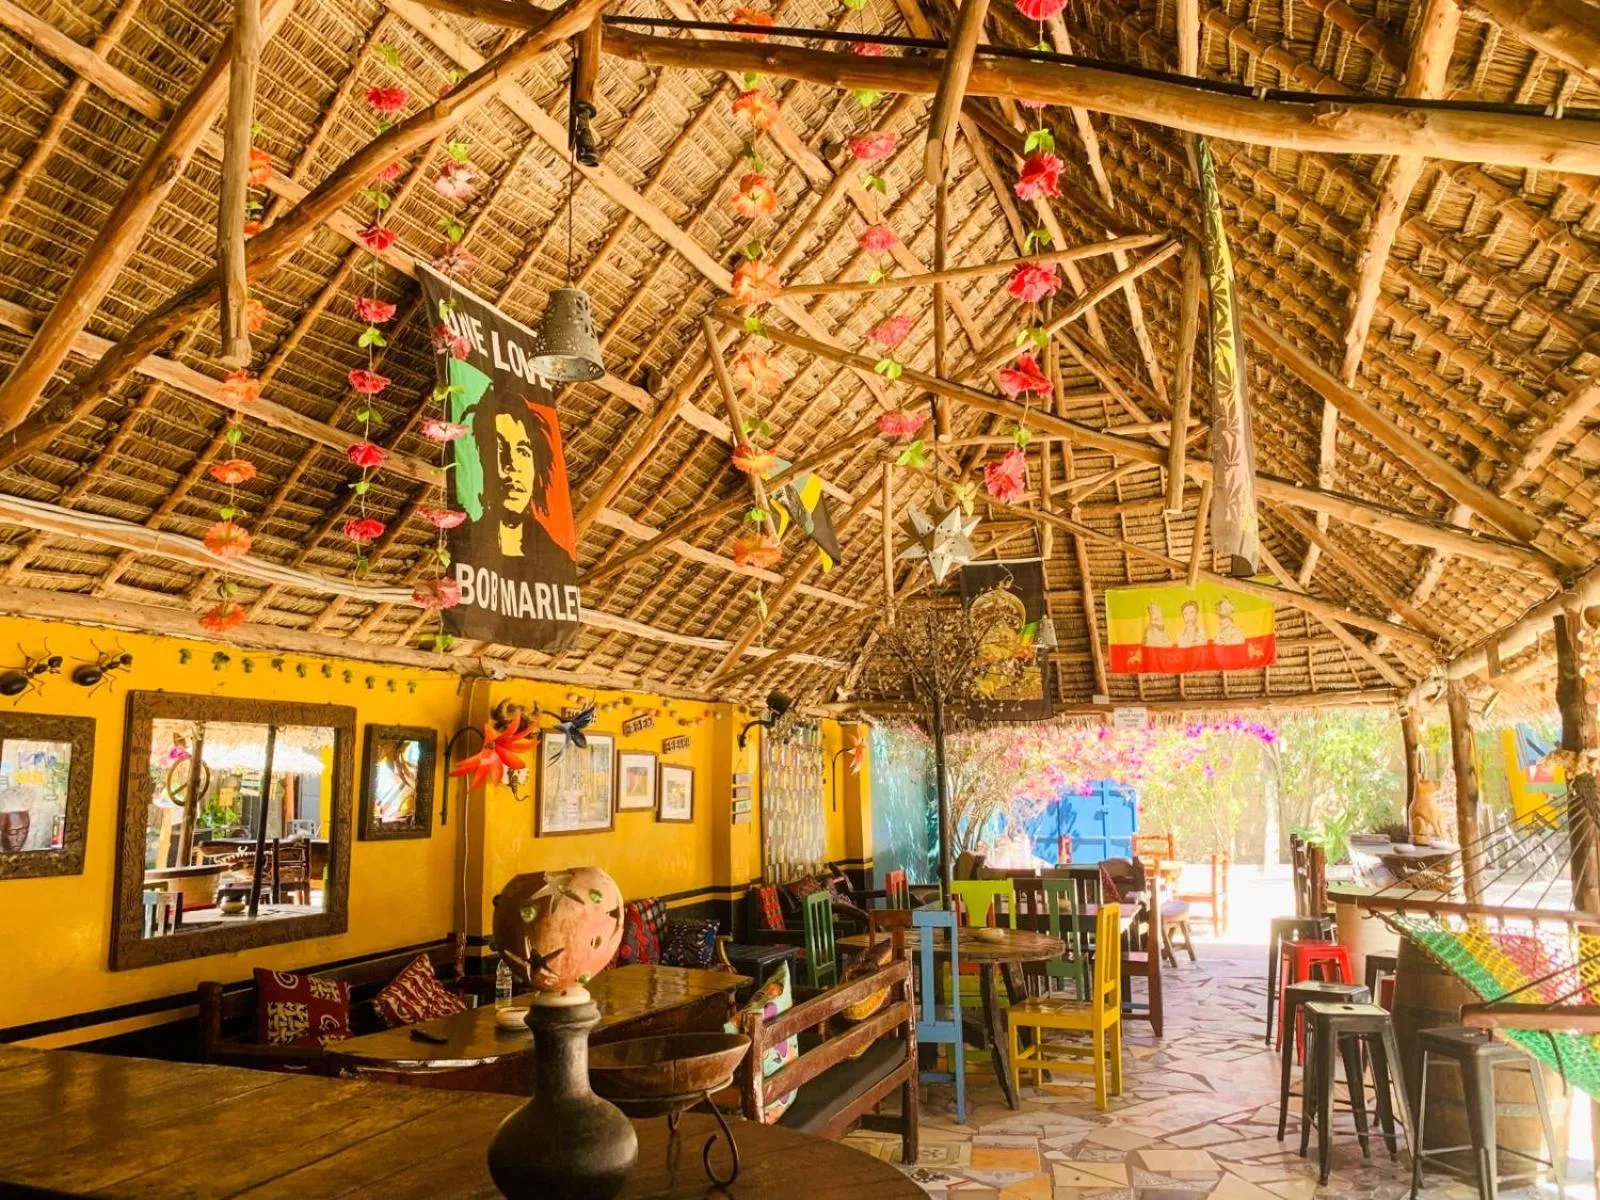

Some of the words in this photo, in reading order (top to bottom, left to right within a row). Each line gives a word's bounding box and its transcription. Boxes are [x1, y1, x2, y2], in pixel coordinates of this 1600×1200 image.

[443, 308, 488, 358] ONE
[456, 562, 498, 612] BOB
[500, 577, 581, 622] MARLE
